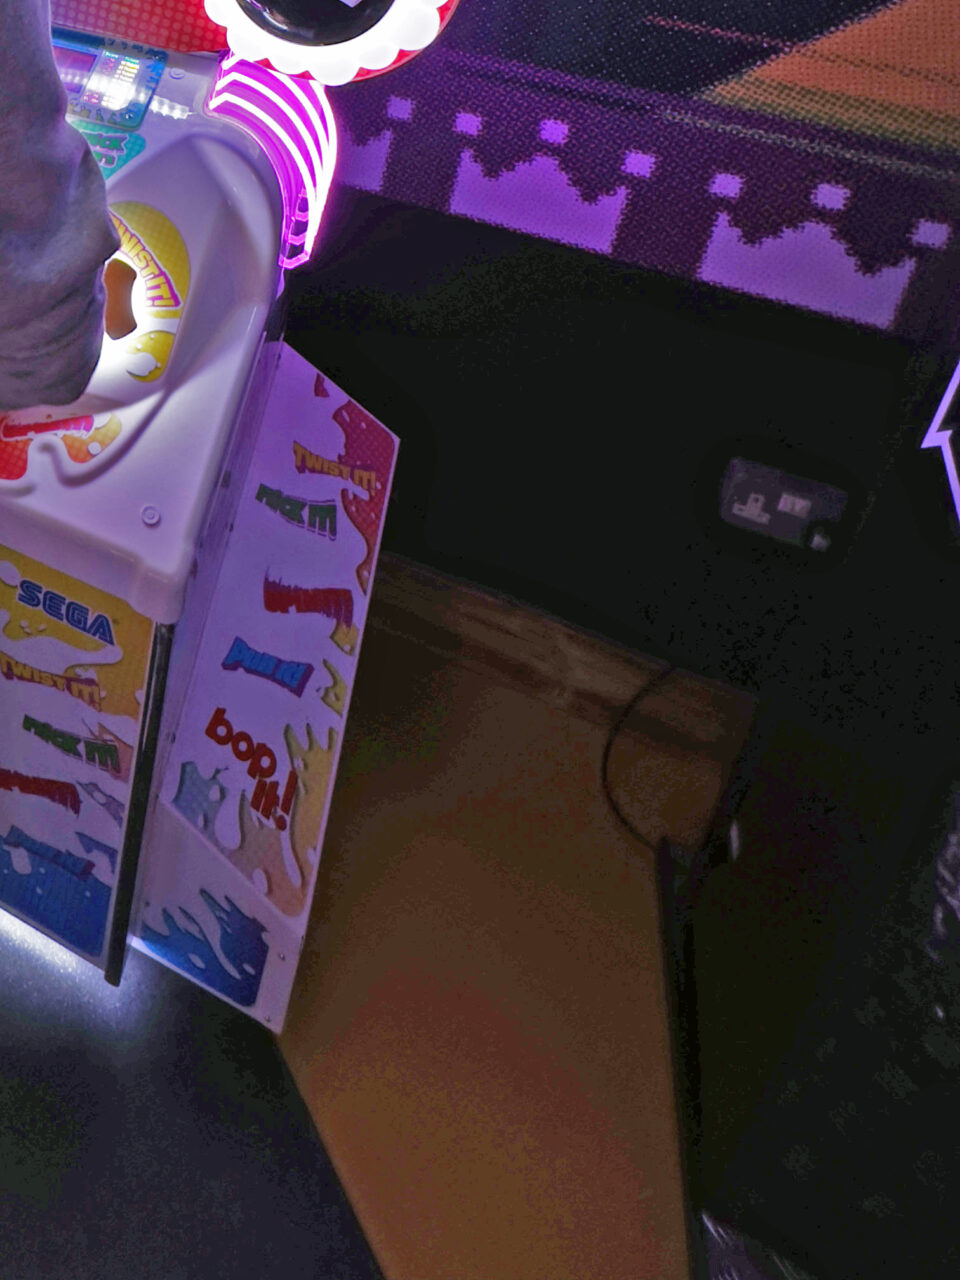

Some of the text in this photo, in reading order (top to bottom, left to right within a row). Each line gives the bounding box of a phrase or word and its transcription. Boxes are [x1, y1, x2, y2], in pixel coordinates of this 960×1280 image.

[293, 440, 351, 481] TWIST
[17, 579, 116, 647] SEGA
[205, 707, 278, 780] bop
[250, 769, 298, 832] It!
